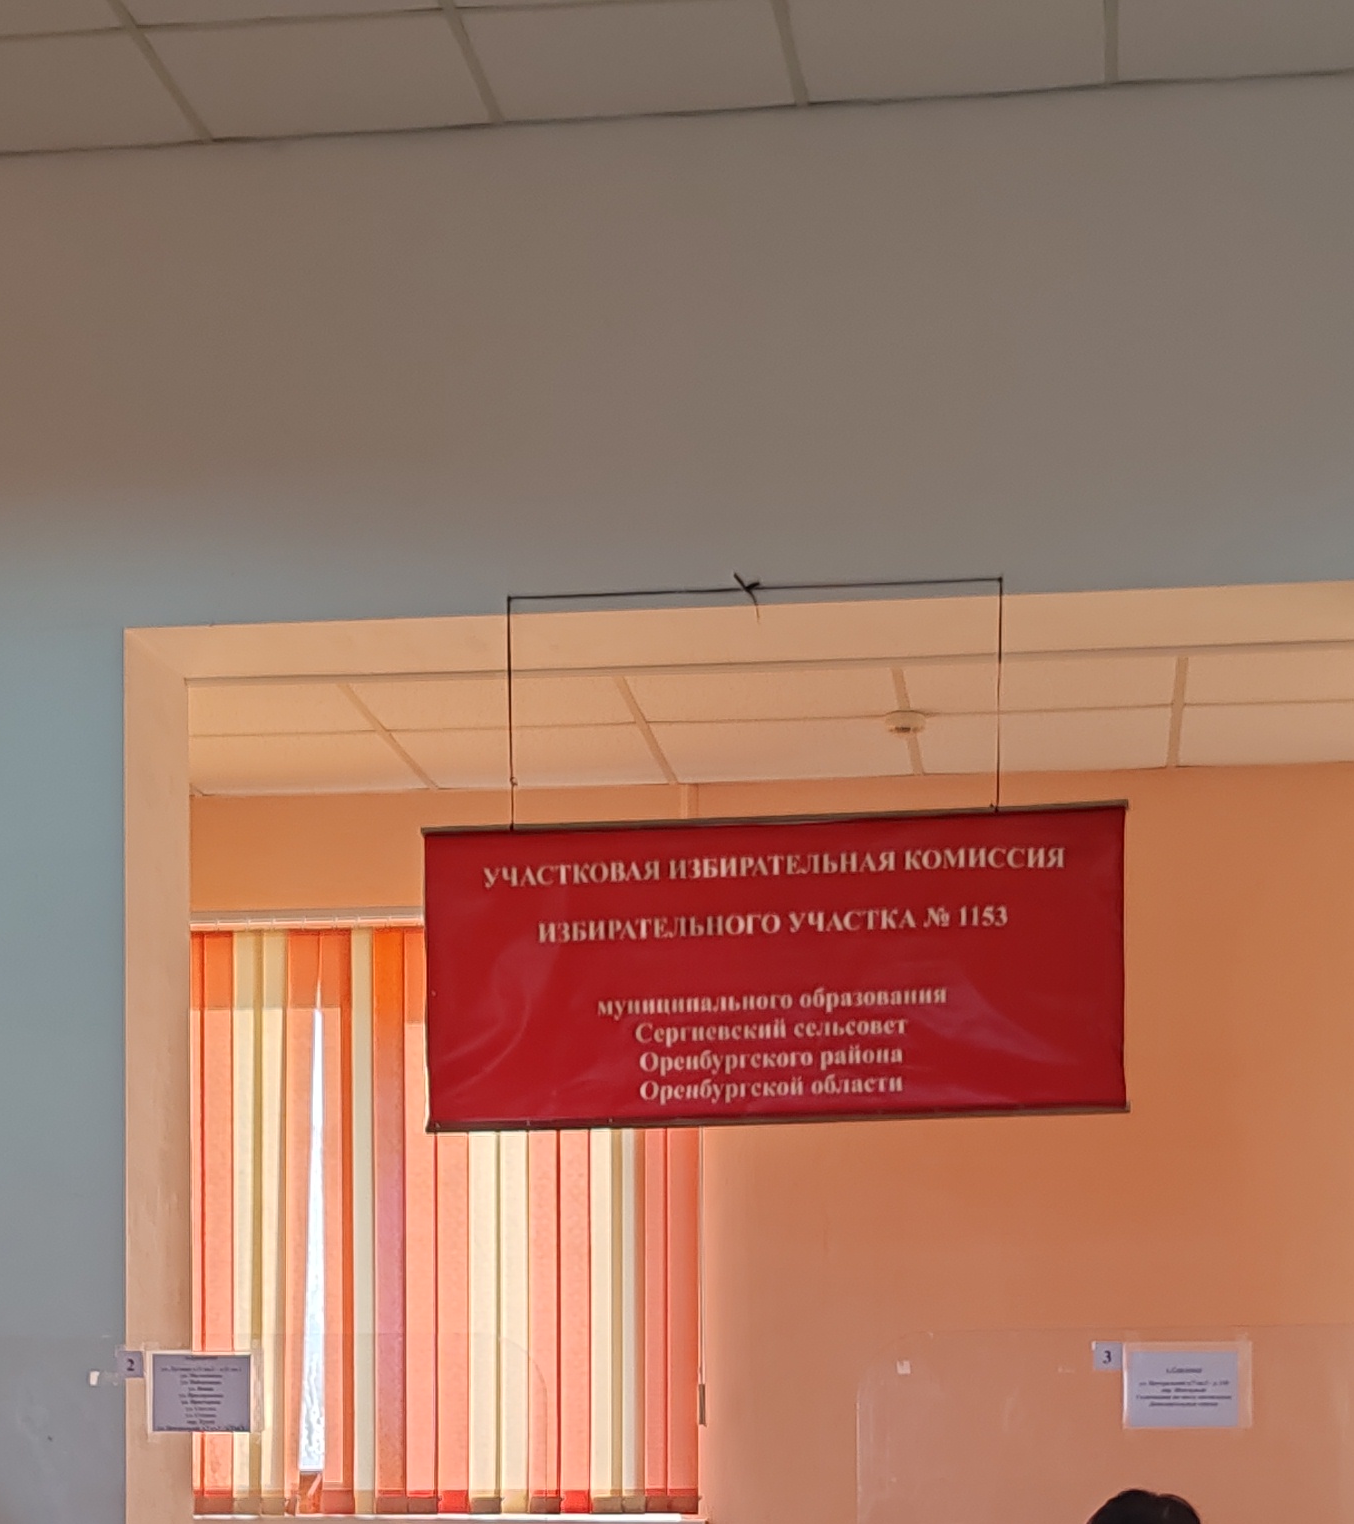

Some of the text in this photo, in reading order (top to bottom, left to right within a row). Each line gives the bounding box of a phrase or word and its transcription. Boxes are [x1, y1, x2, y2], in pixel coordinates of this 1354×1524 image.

[483, 846, 1066, 888] УЧАСТКОВАЯ ИЗБИРАТЕЛЬНАЯ КОМИССИЯ
[538, 905, 1009, 943] ИЗБИРАТЕЛЬНОГО УЧАСТКА № 1153
[597, 986, 947, 1021] муниципального образования
[635, 1017, 907, 1048] Сергиевский сельсовет
[639, 1044, 903, 1077] Оренбургского района
[639, 1073, 903, 1106] Оренбургской области
[126, 1358, 135, 1371] 2
[1102, 1350, 1112, 1364] 3
